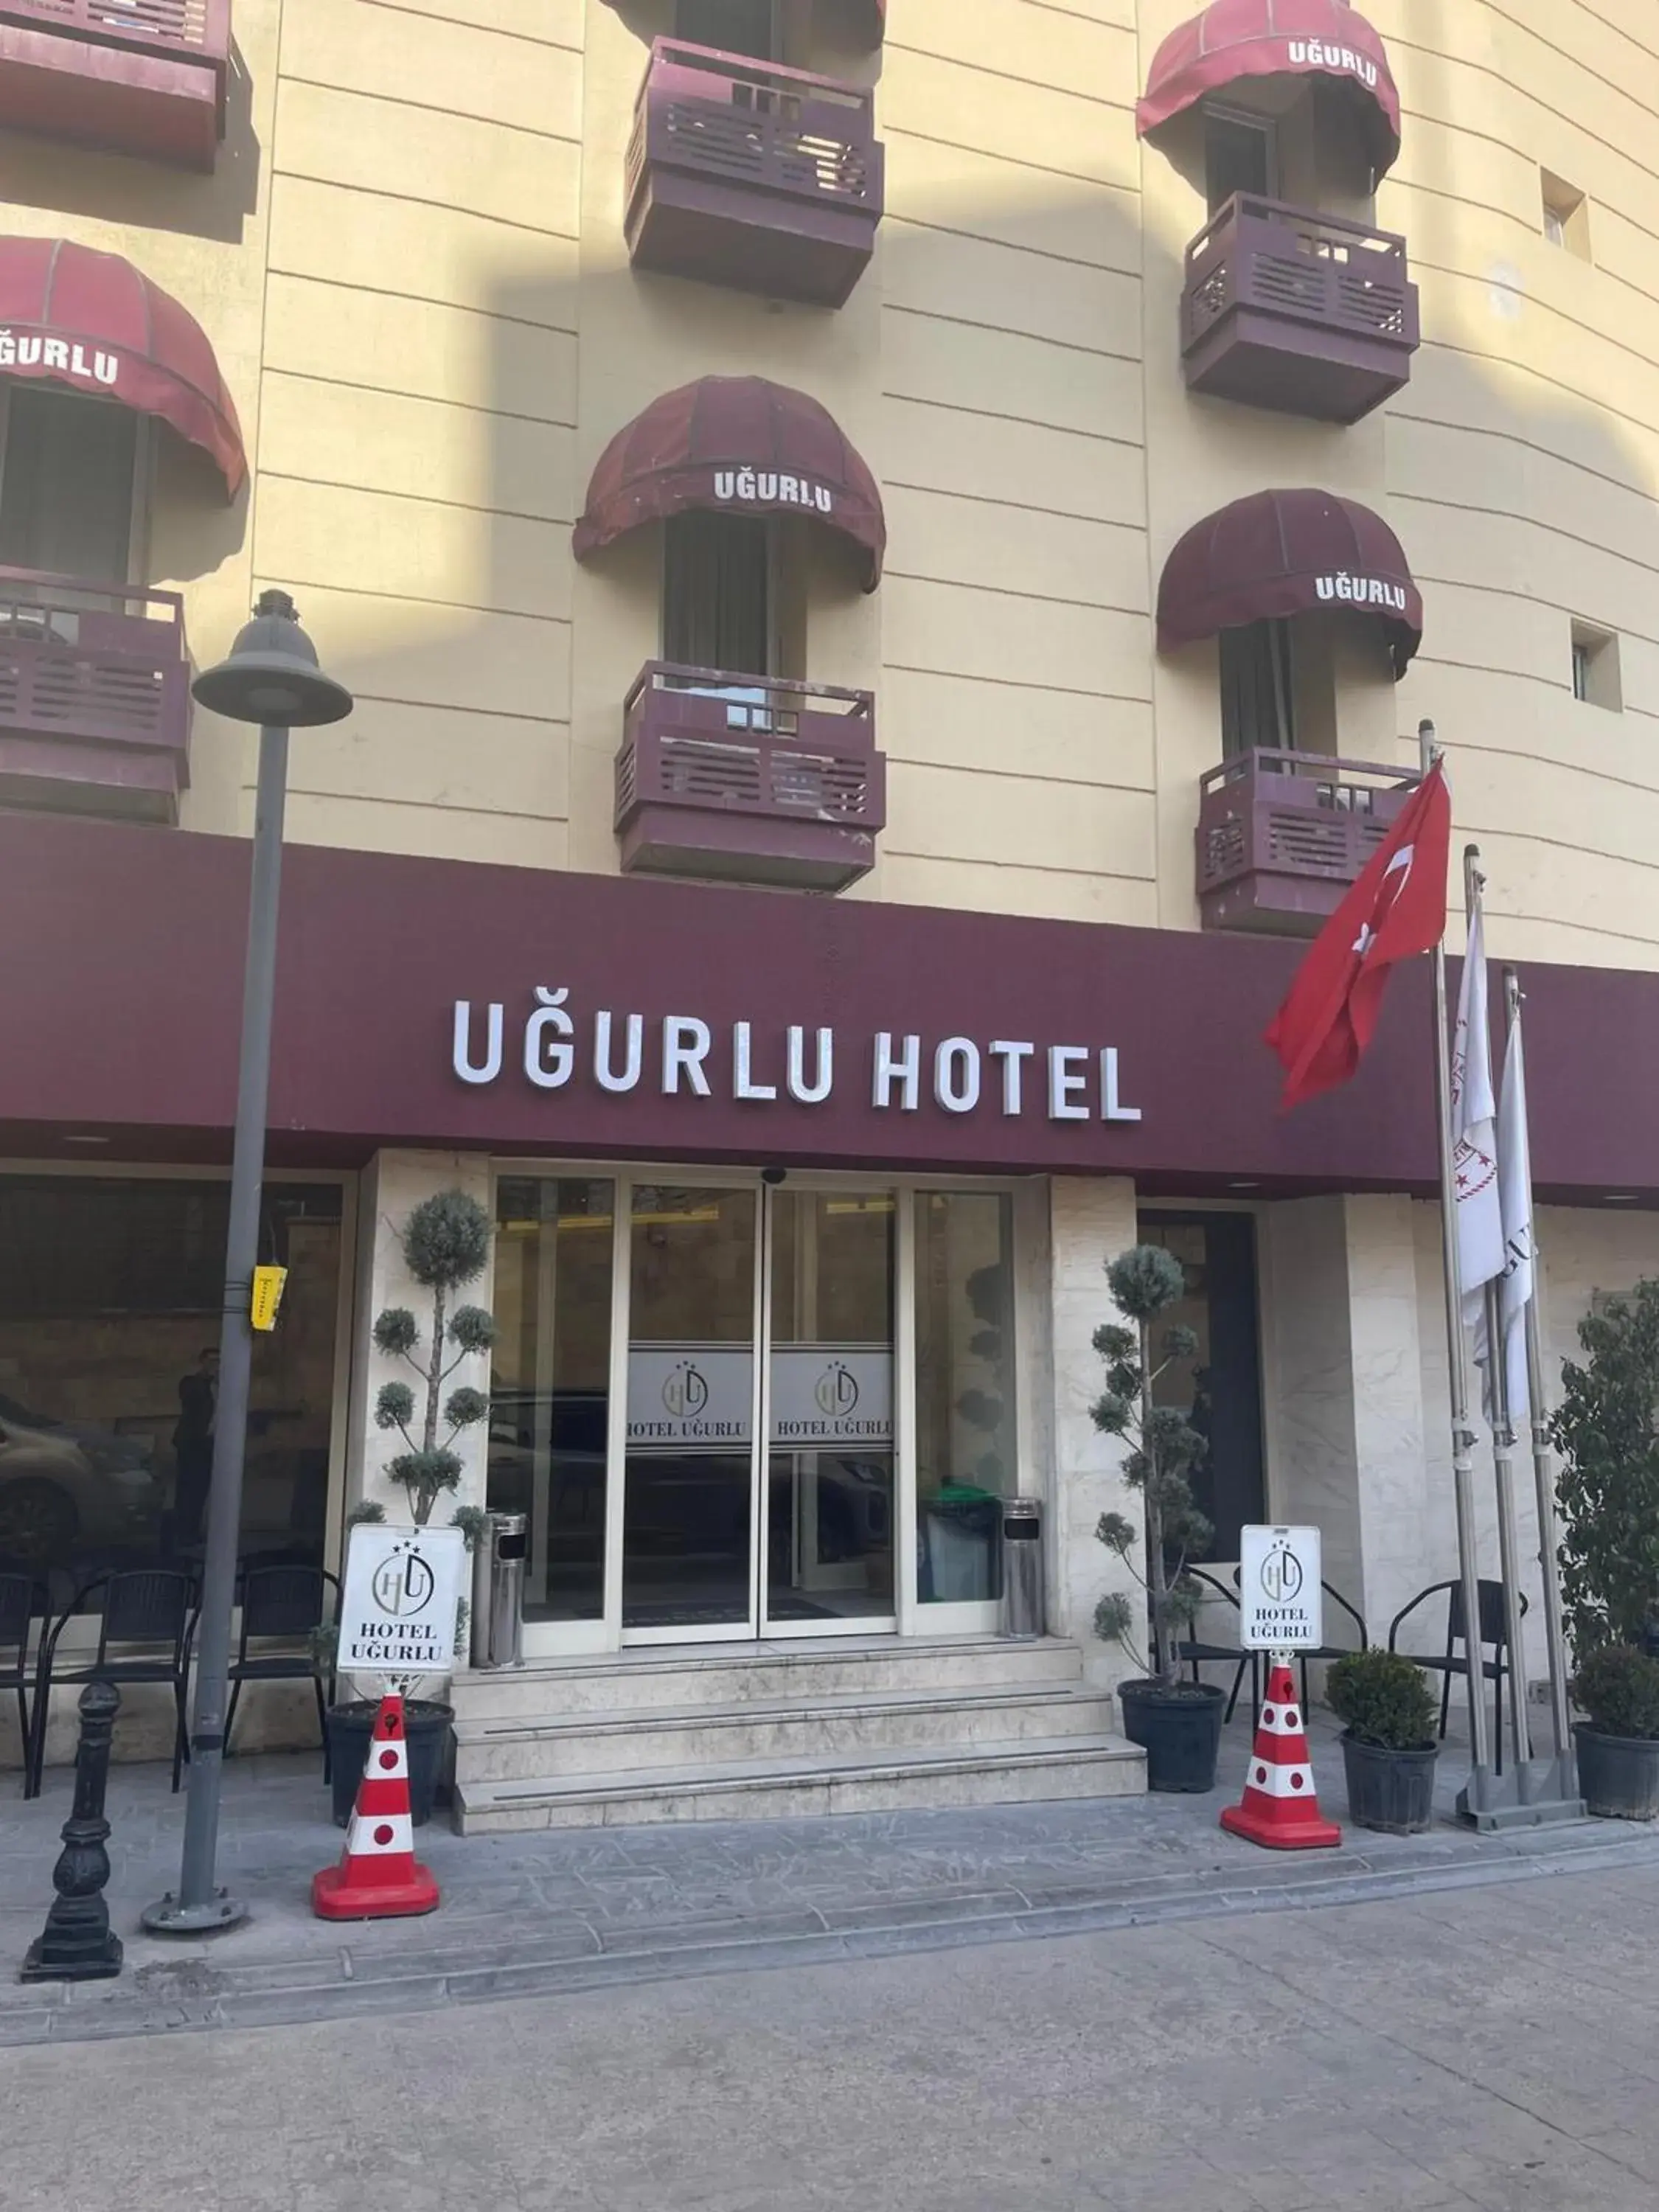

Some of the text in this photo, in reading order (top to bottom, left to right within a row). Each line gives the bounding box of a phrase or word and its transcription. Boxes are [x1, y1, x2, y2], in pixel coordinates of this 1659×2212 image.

[1288, 38, 1377, 86] UĞURLU
[714, 466, 832, 512] UĞURLU
[1315, 571, 1405, 611] UĞURLU
[452, 985, 1141, 1121] UĞURLU HOTEL
[778, 1420, 830, 1436] HOTEL
[1256, 1608, 1309, 1621] HOTEL
[361, 1623, 437, 1639] HOTEL
[1251, 1623, 1313, 1638] UĞURLU
[352, 1641, 442, 1660] UĞURLU
